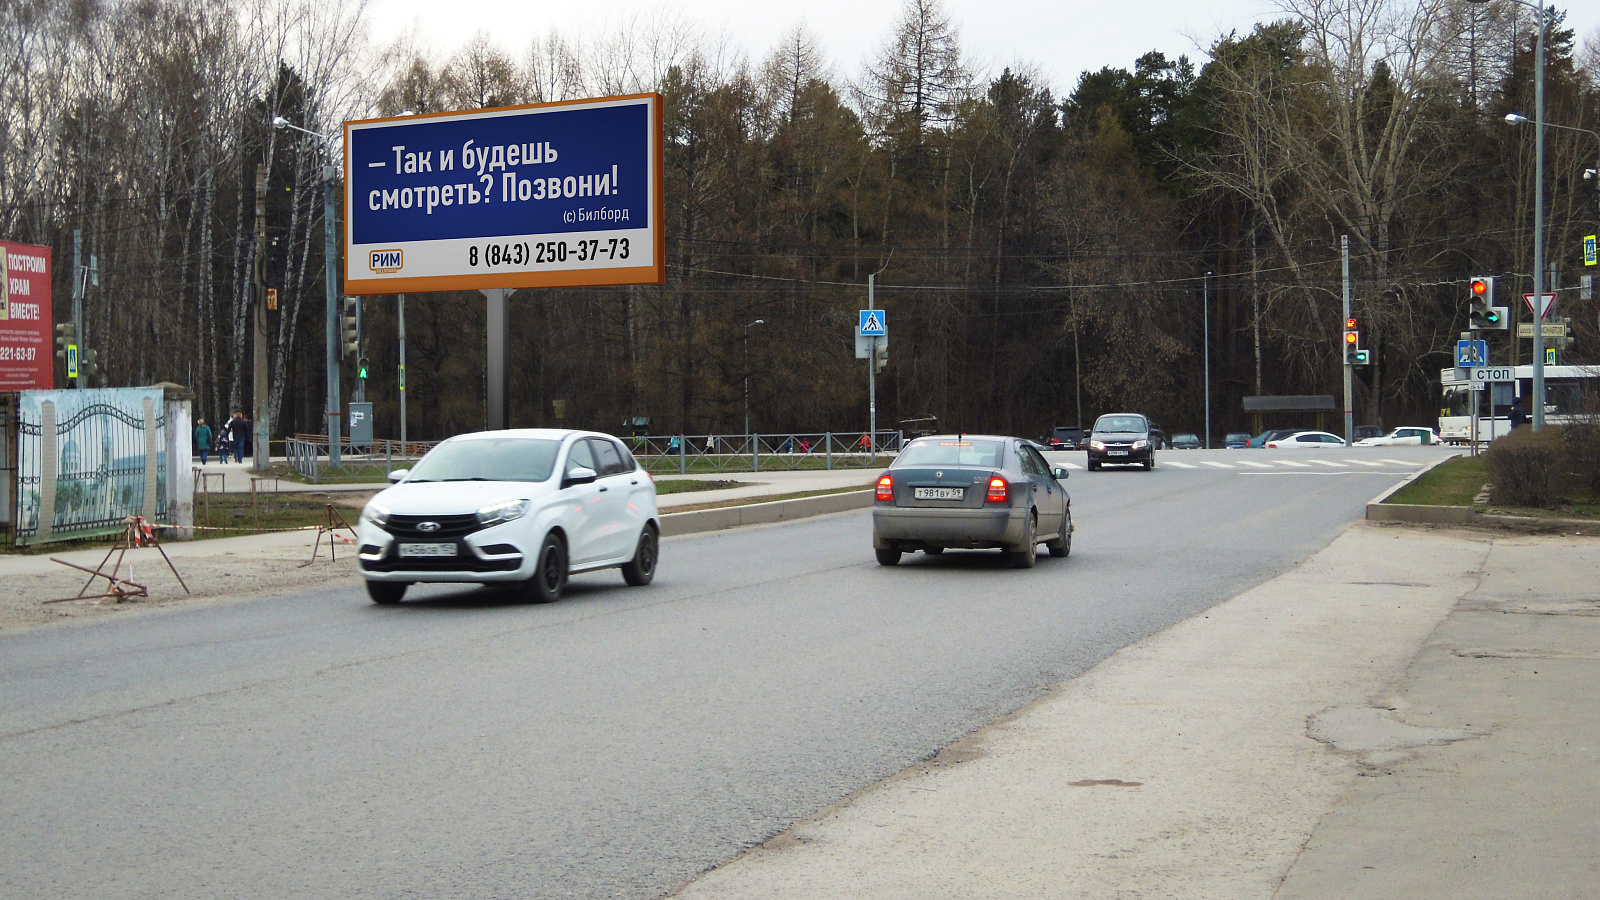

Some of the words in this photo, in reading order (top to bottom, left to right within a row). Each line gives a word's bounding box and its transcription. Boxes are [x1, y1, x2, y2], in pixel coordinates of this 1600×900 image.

[392, 145, 432, 175] Так
[440, 149, 453, 172] и
[462, 139, 558, 176] будешь
[368, 174, 494, 215] смотреть?
[502, 164, 618, 202] Позвони!
[578, 206, 630, 223] Билборд
[372, 252, 400, 268] РИМ
[469, 245, 479, 267] 8
[485, 241, 530, 267] (843)
[535, 237, 630, 264] 250-37-73
[8, 253, 46, 274] ПОСТРОИМ
[9, 277, 30, 296] ХРАМ
[10, 302, 40, 320] ВМЕСТЕ!
[0, 346, 36, 361] 221-63-87
[1477, 369, 1509, 380] СТОП
